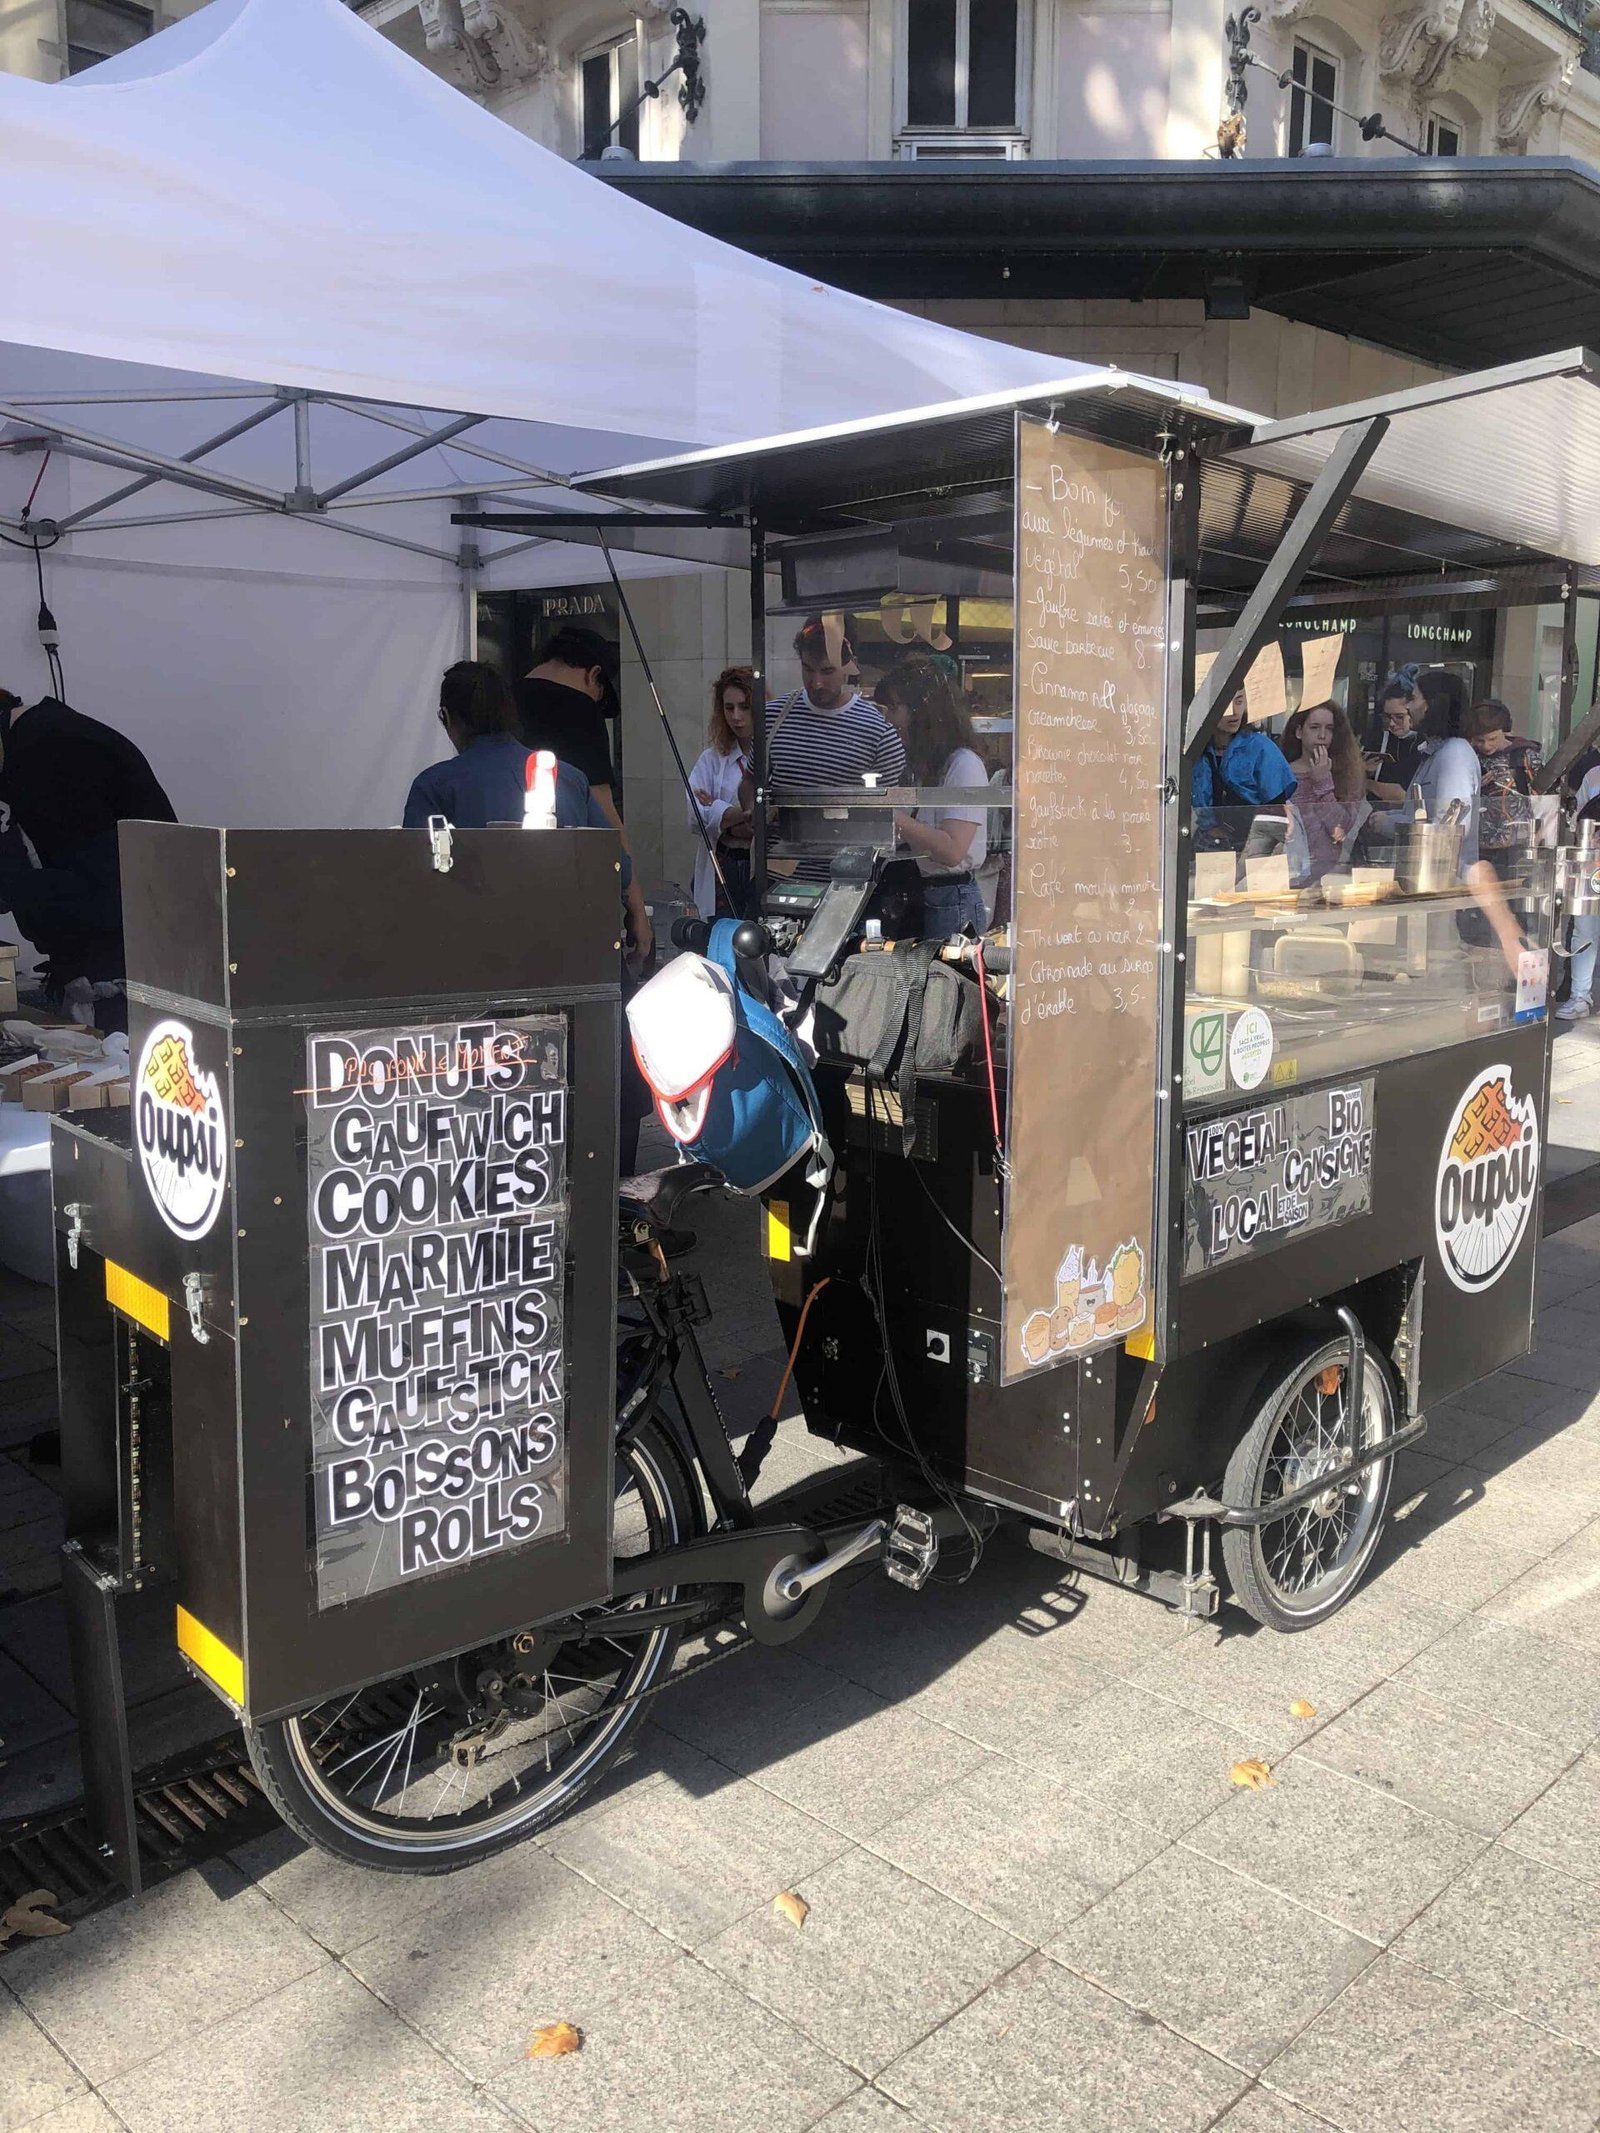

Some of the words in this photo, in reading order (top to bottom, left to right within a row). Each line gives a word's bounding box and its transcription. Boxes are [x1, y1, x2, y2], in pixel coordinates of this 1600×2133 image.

[543, 594, 606, 617] PRADA
[1408, 623, 1472, 643] LONGCHAMP
[1030, 862, 1066, 908] Café
[1099, 961, 1117, 975] au
[312, 1022, 526, 1109] DONUTS
[1246, 1021, 1258, 1035] ICI
[140, 1091, 222, 1181] Oupsi
[331, 1090, 565, 1174] GAUFWICH
[1187, 1108, 1289, 1181] VEGETAL
[1329, 1091, 1363, 1139] BIO
[314, 1147, 551, 1238] COOKIES
[1283, 1130, 1372, 1196] CONSIGNE
[1440, 1120, 1535, 1233] Oupsi
[1211, 1184, 1284, 1255] LOCAL
[323, 1211, 554, 1313] MARMITE
[320, 1289, 548, 1392] MUFFINS
[332, 1349, 561, 1457] GAUFSTICK
[329, 1412, 557, 1525] BOISSONS
[400, 1479, 543, 1575] ROLLS
